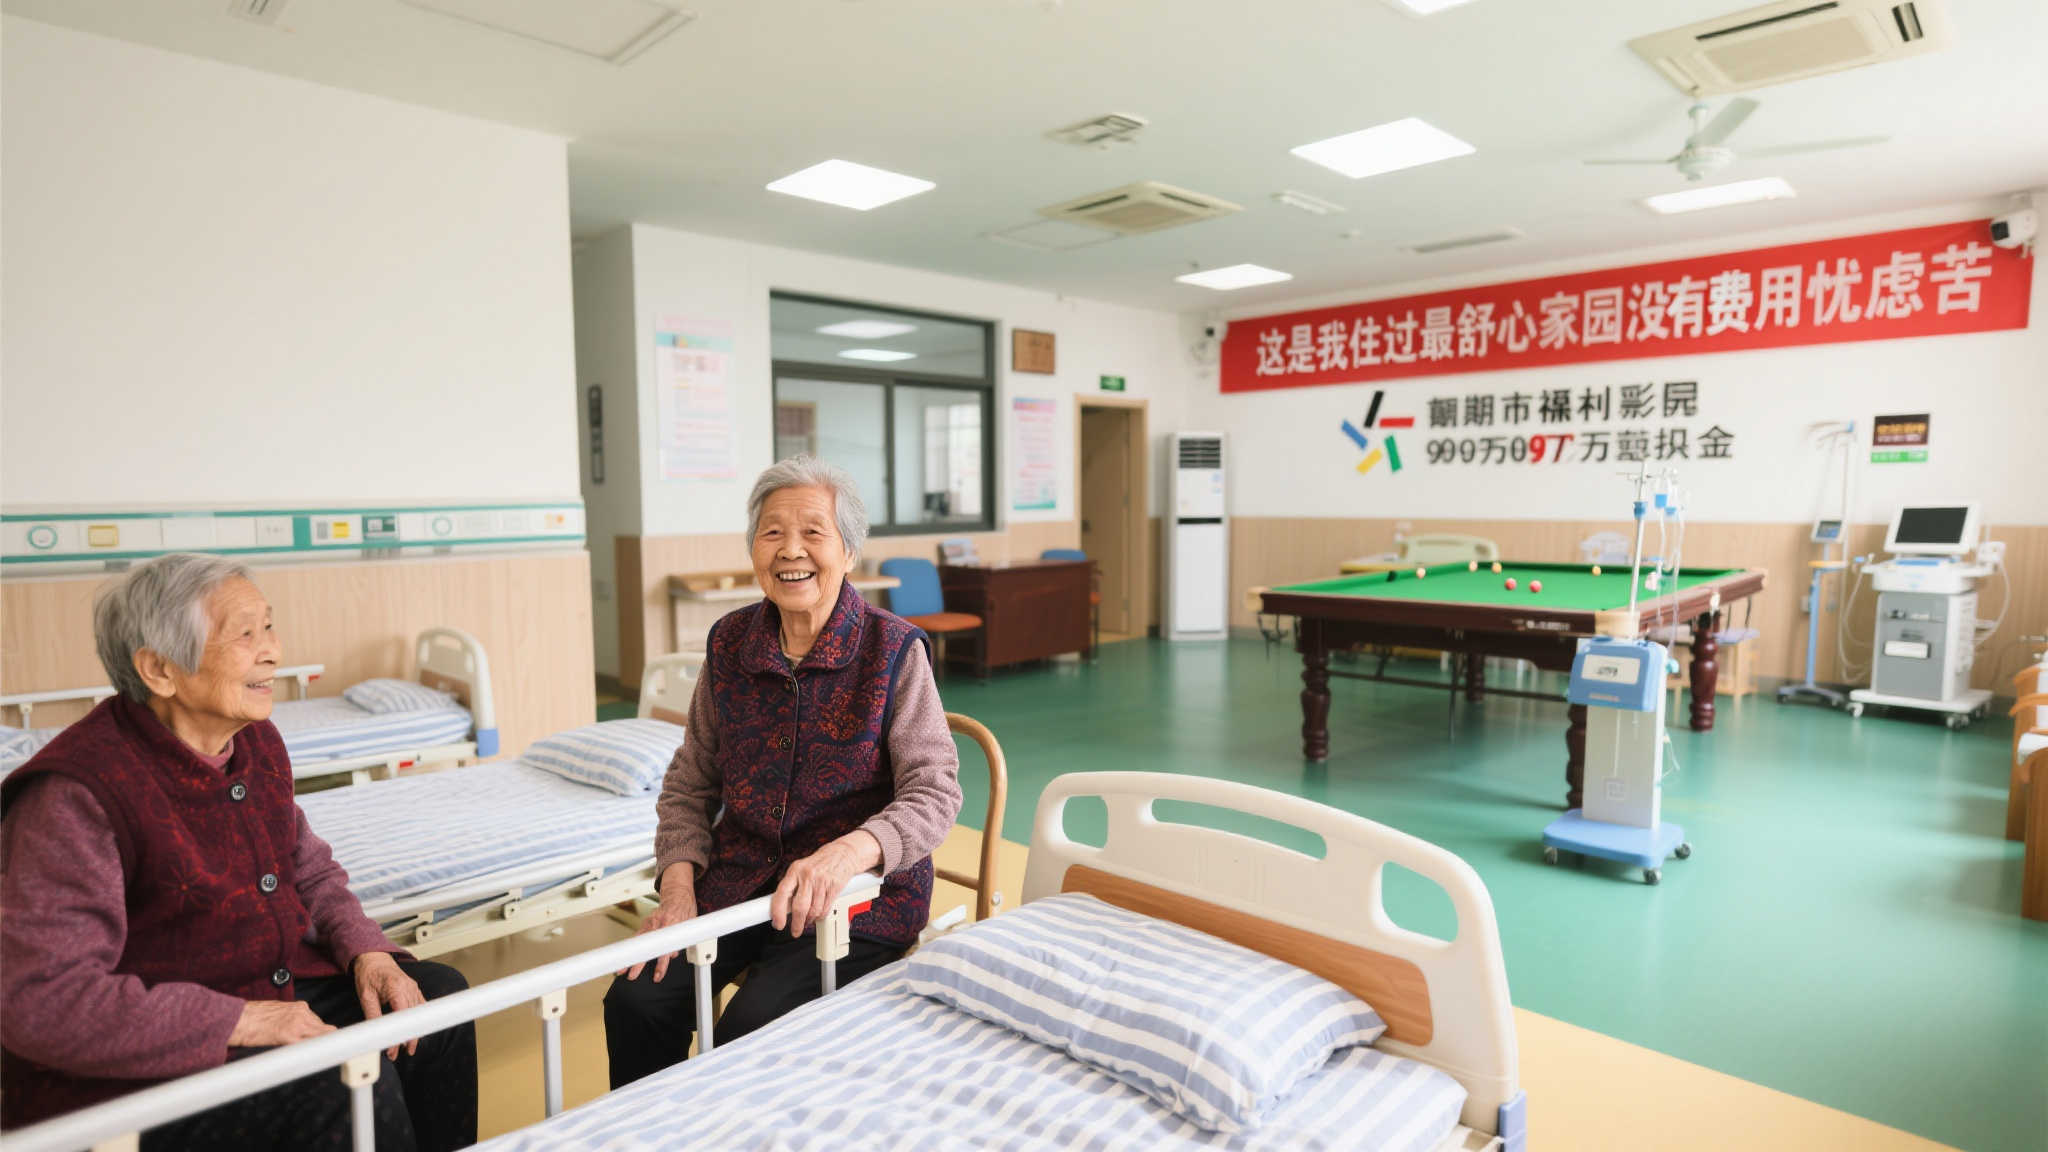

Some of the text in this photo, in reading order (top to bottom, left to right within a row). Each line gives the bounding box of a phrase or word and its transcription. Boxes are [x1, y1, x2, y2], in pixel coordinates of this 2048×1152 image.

[1256, 243, 1992, 376] 这是我住过最舒心家园没有费用忧虑苦
